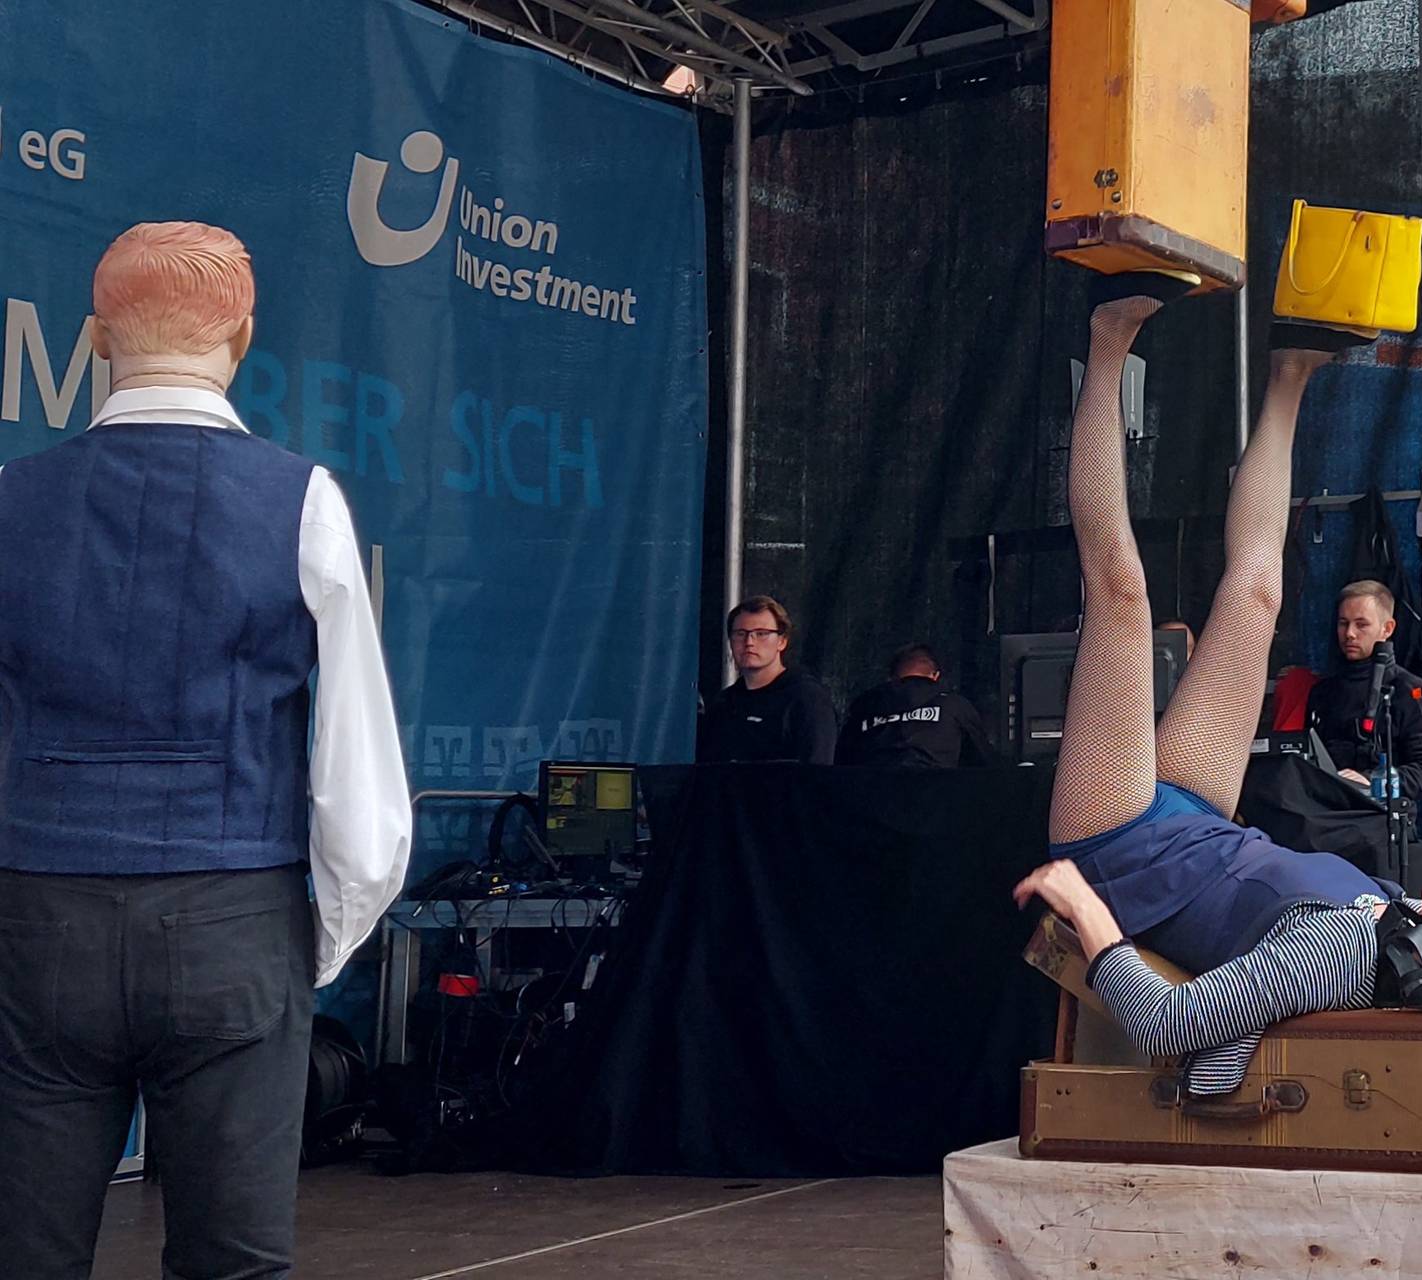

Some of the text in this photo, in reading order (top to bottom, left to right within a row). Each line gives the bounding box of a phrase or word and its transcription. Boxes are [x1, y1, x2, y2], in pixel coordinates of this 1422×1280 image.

[19, 128, 86, 180] eG
[460, 185, 558, 255] Union
[456, 235, 638, 325] Investment
[238, 349, 407, 484] BER
[442, 390, 604, 508] SICH
